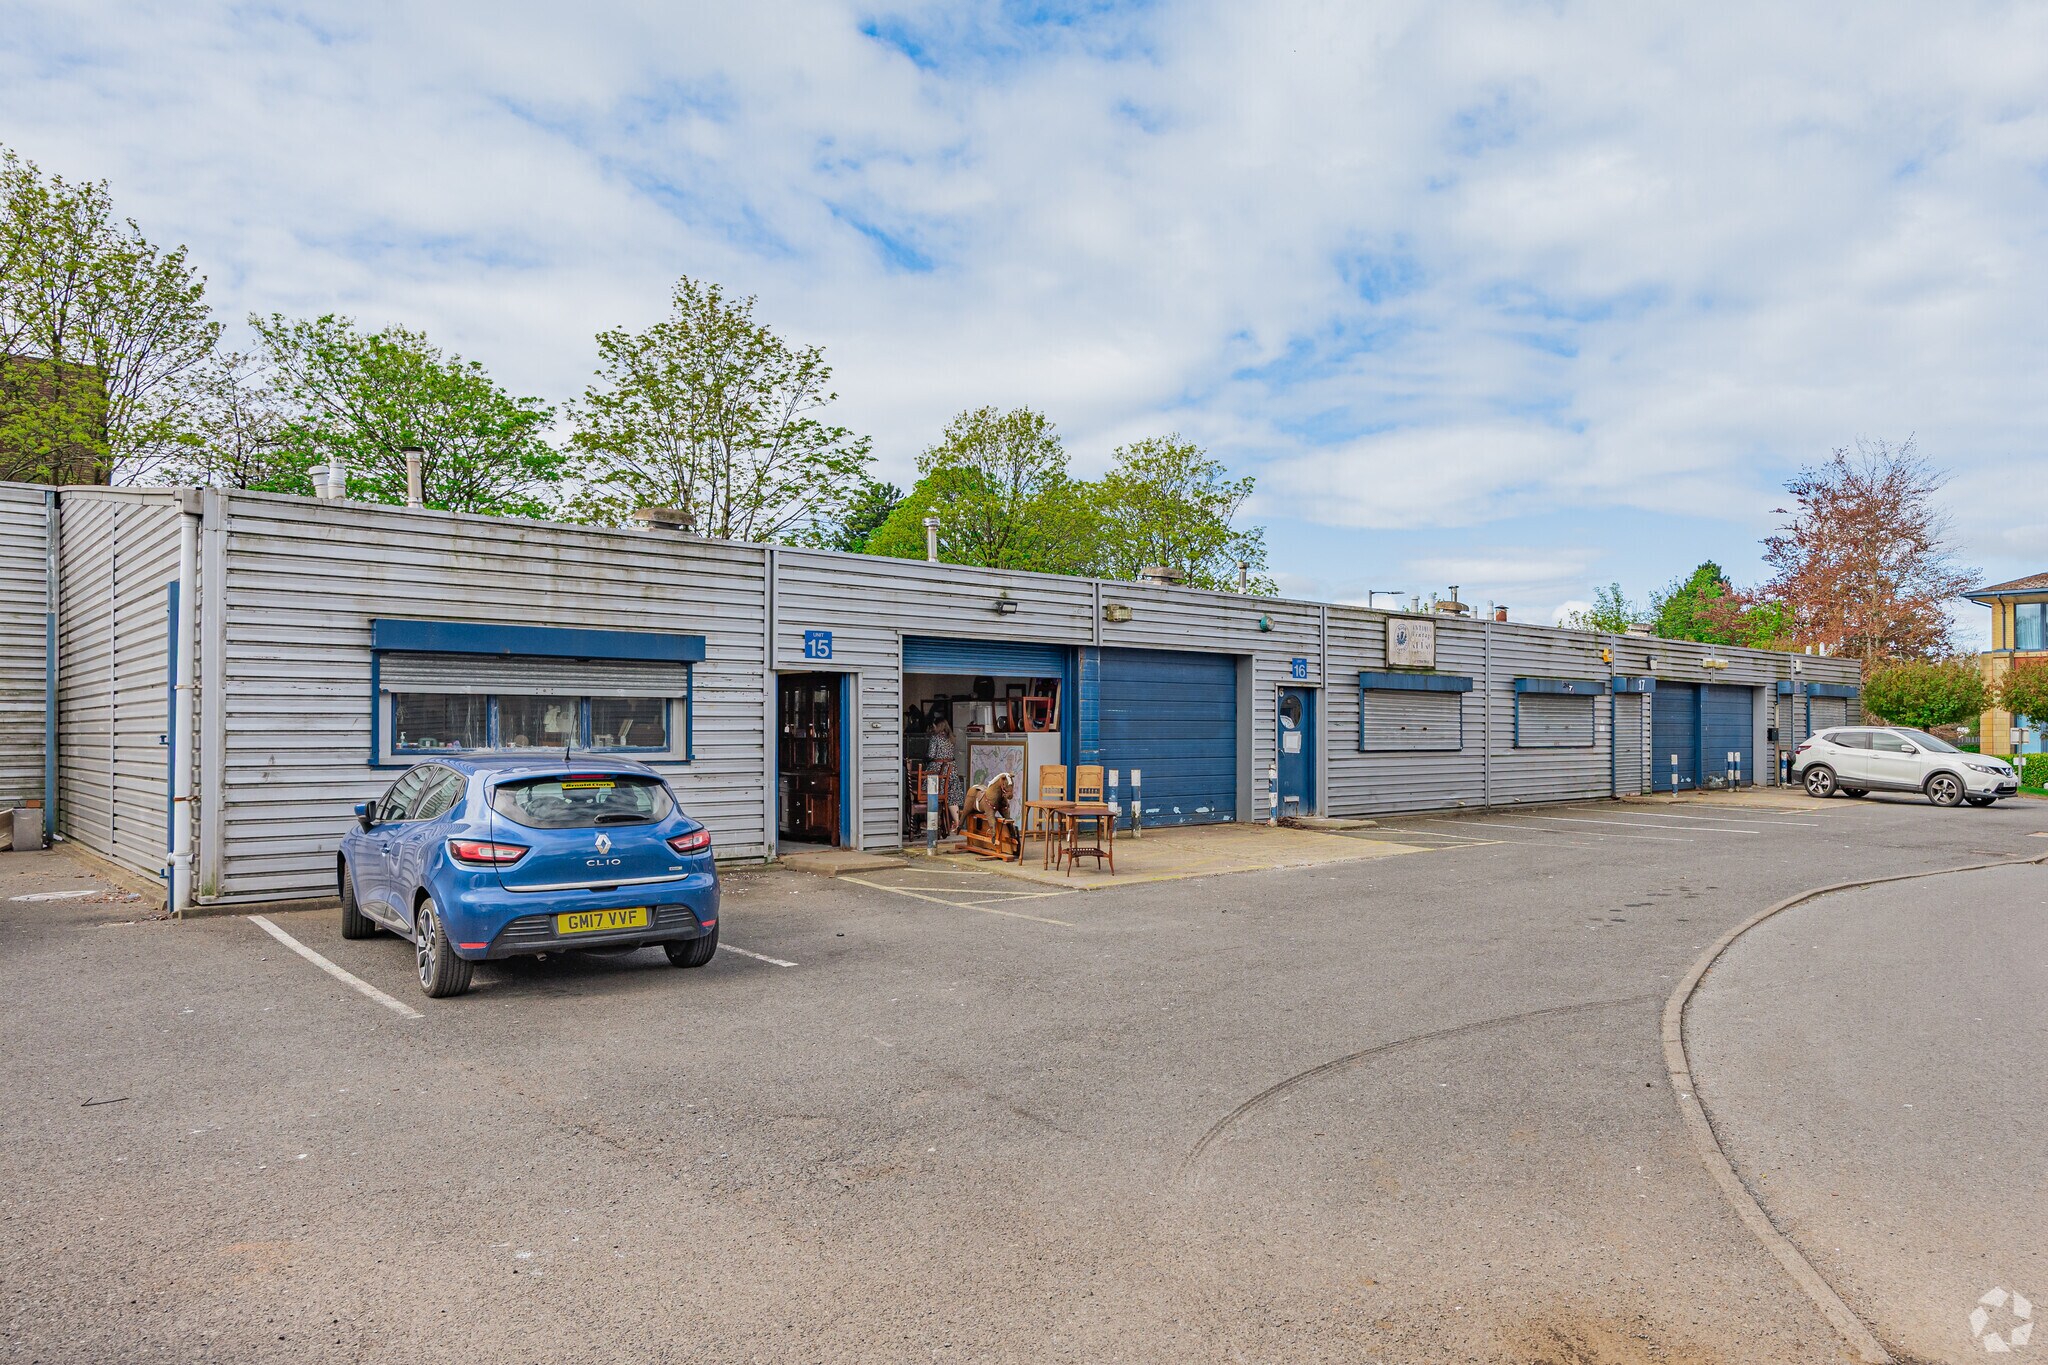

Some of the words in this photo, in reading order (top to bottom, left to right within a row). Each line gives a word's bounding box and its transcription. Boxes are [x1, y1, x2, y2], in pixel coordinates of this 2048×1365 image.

[807, 639, 830, 658] 15
[1293, 664, 1306, 678] 16
[1638, 679, 1646, 691] 17
[586, 858, 621, 867] CLIO
[568, 913, 603, 930] GM17
[608, 910, 637, 926] VVF
